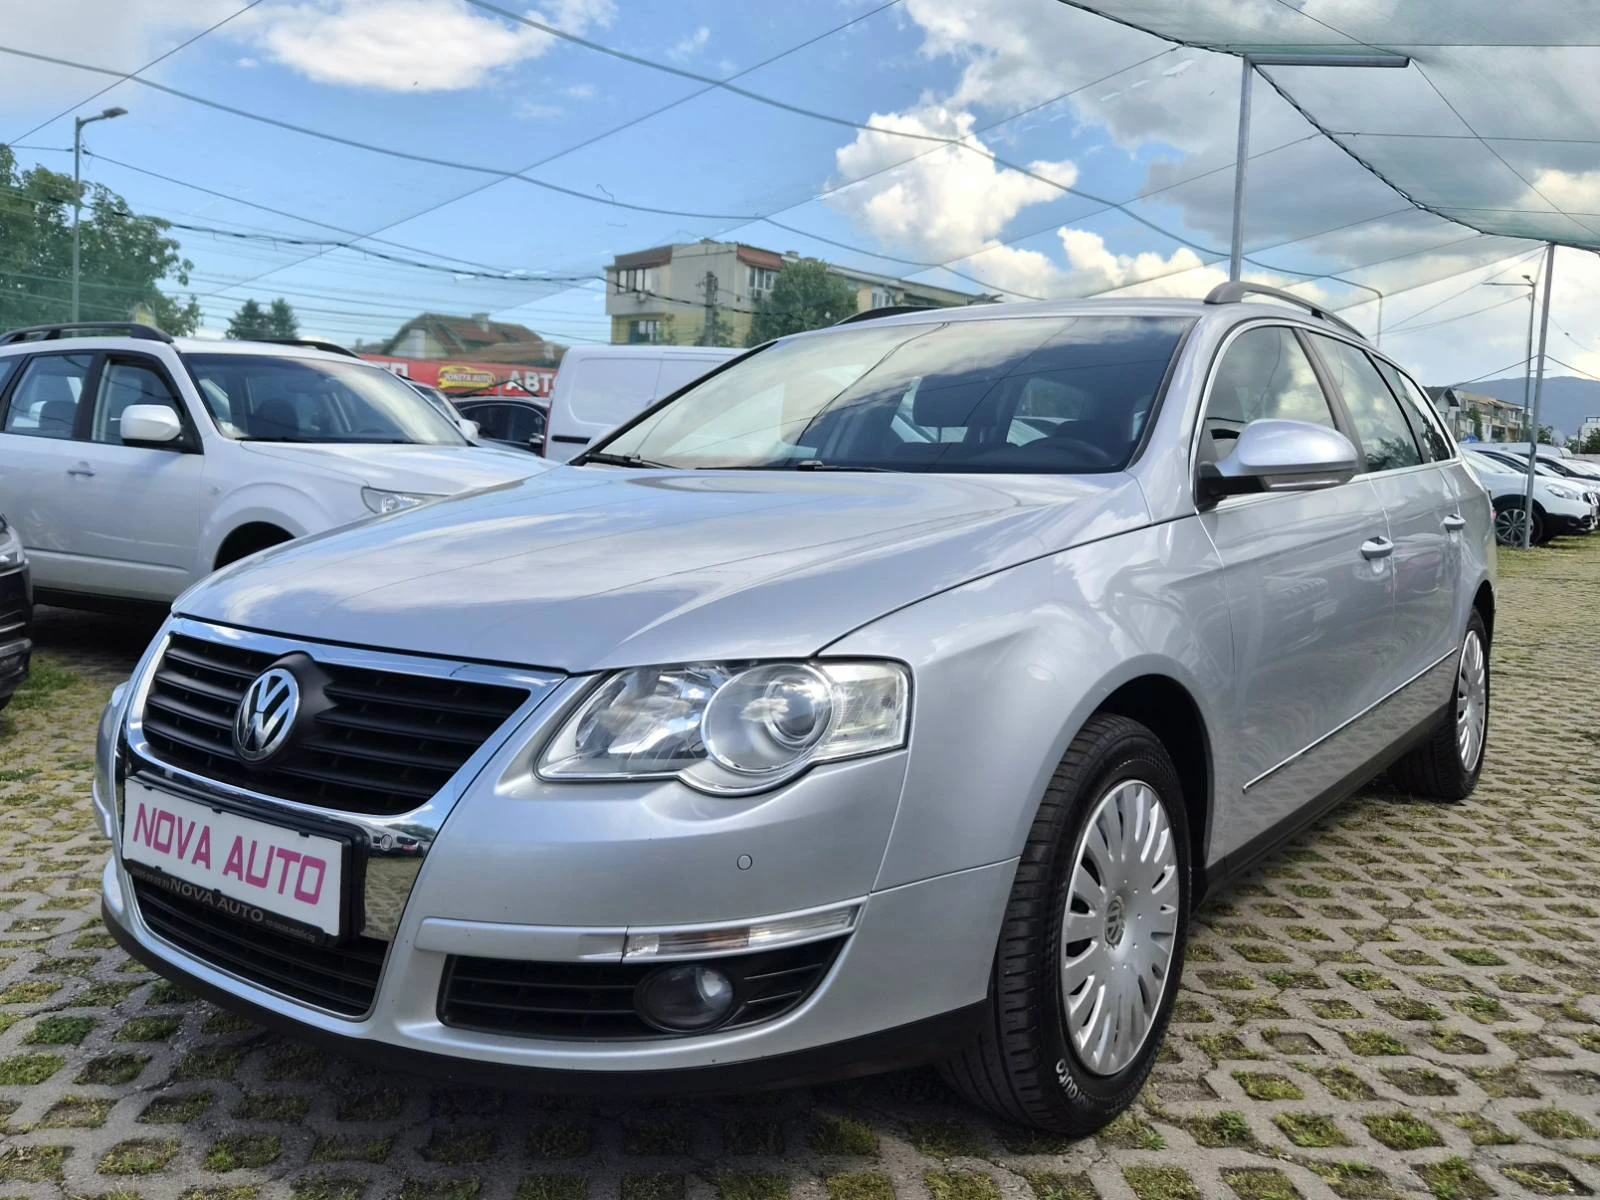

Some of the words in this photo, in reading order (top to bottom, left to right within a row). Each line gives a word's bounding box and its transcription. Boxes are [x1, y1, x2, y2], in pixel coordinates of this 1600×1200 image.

[133, 803, 211, 869] NOVA
[222, 835, 327, 905] AUTO
[170, 877, 213, 905] NOVA
[216, 896, 263, 922] AUTO
